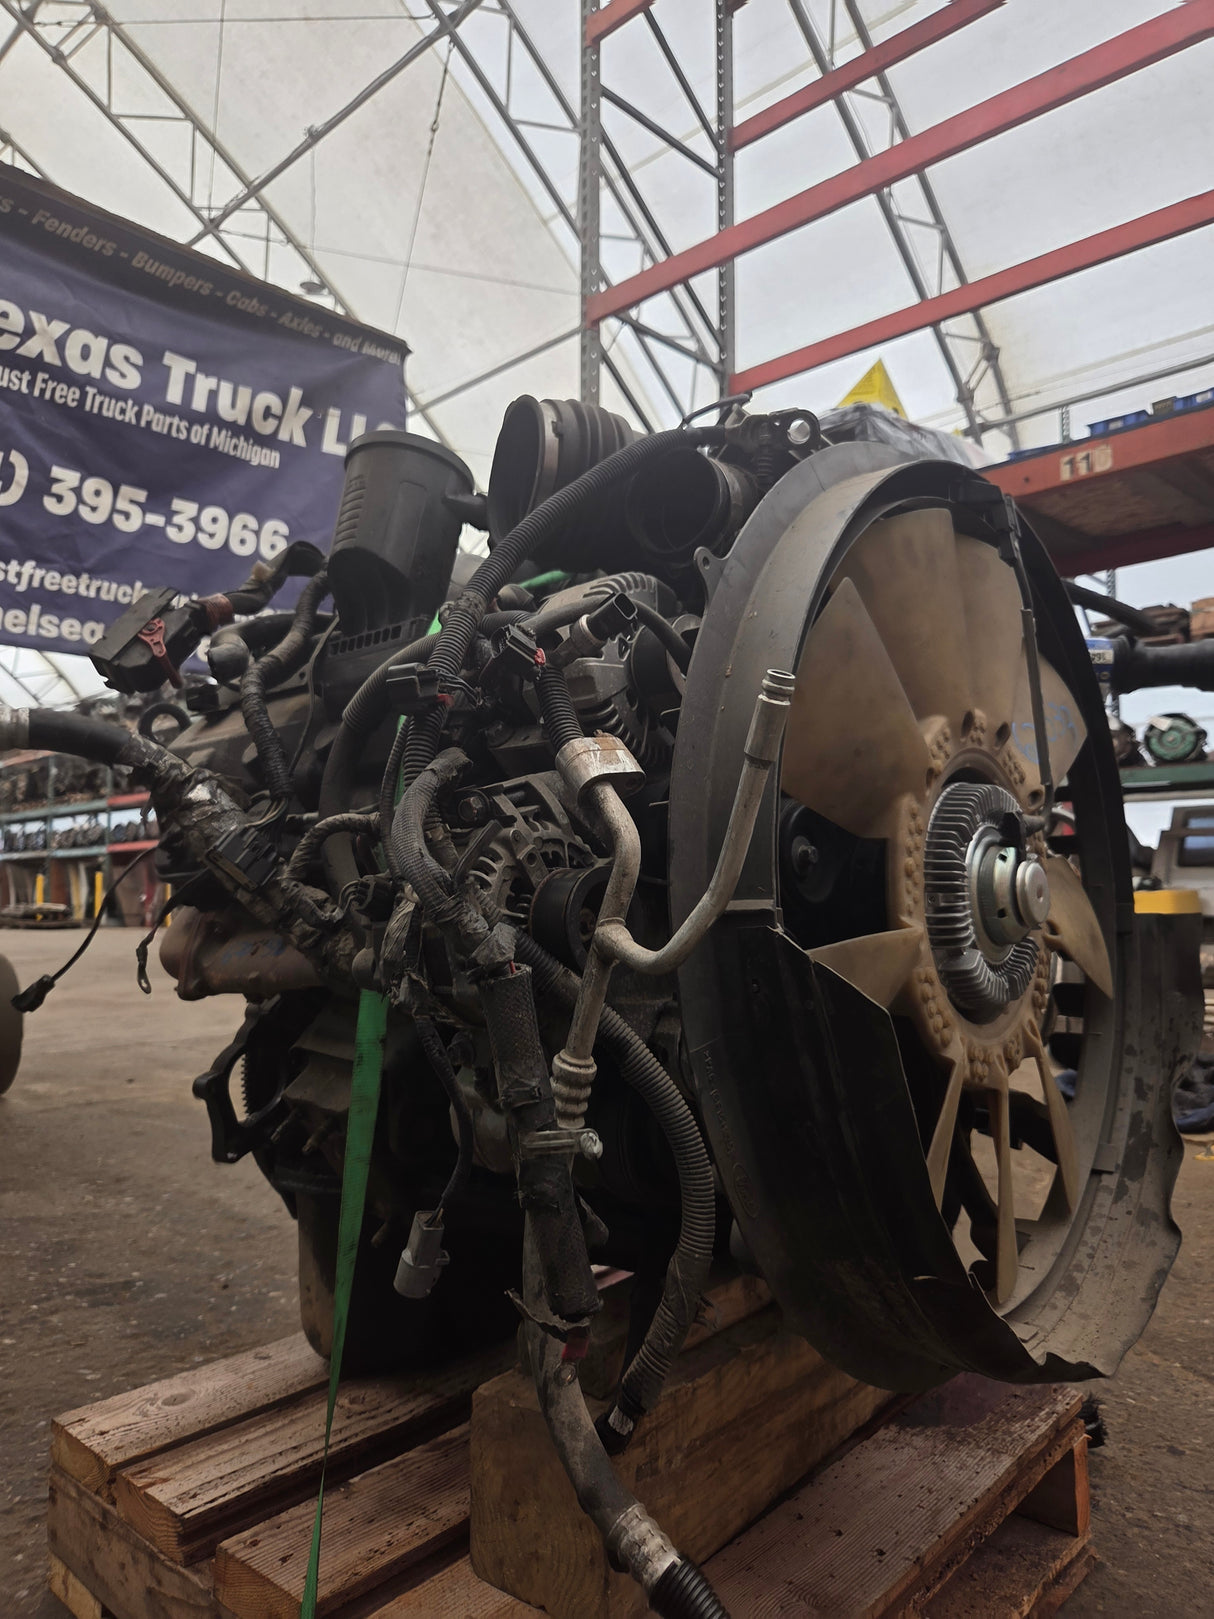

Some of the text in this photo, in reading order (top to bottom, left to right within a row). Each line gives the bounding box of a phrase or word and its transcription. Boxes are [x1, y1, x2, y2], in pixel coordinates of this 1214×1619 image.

[31, 209, 117, 257] Fenders
[131, 251, 213, 296] Bumpers
[226, 290, 268, 317] Cabs
[277, 312, 323, 338] Axles
[333, 333, 362, 352] and
[0, 299, 143, 390] exas
[162, 350, 313, 448] Truck
[0, 365, 280, 469] ust Free Truck Parts of Michigan
[43, 465, 290, 561] 395-3966
[0, 603, 105, 645] elsea
